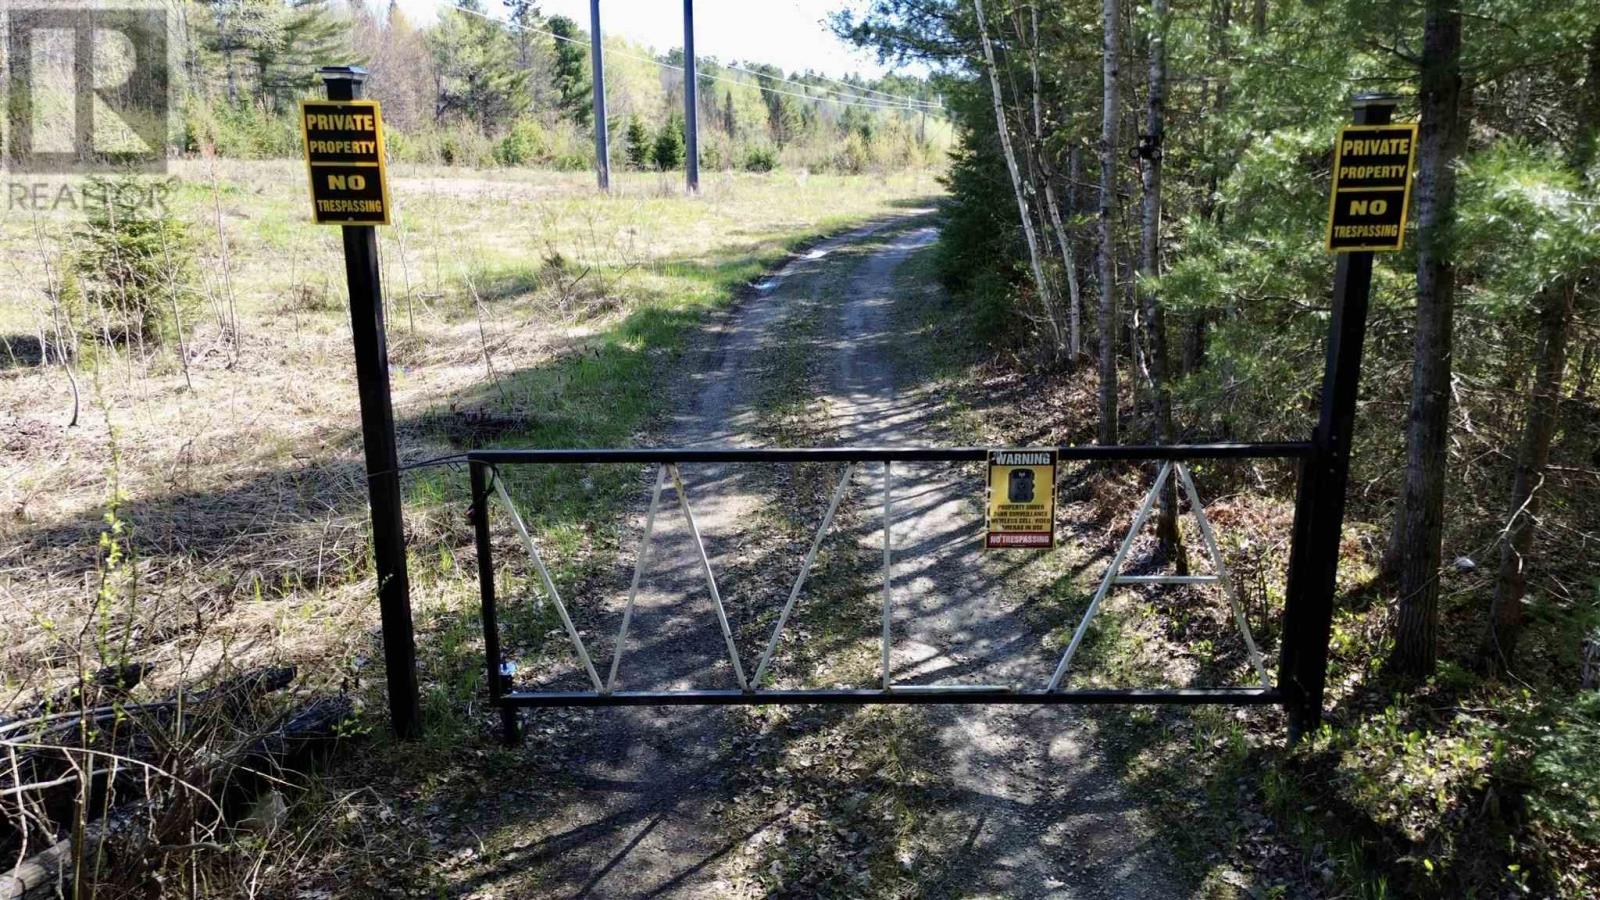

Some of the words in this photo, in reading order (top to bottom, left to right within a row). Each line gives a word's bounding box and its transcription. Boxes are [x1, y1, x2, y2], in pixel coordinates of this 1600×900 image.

[306, 114, 375, 131] PRIVATE
[309, 141, 376, 154] PROPERTY
[1342, 138, 1409, 156] PRIVATE
[1339, 165, 1406, 179] PROPERTY
[327, 174, 366, 190] NO
[316, 199, 382, 213] TRESPASSING
[1349, 200, 1388, 216] NO
[1334, 224, 1398, 238] TRESPASSING
[995, 453, 1050, 465] WARNING
[990, 535, 1001, 544] NO
[1002, 535, 1050, 544] TRESPASSING
